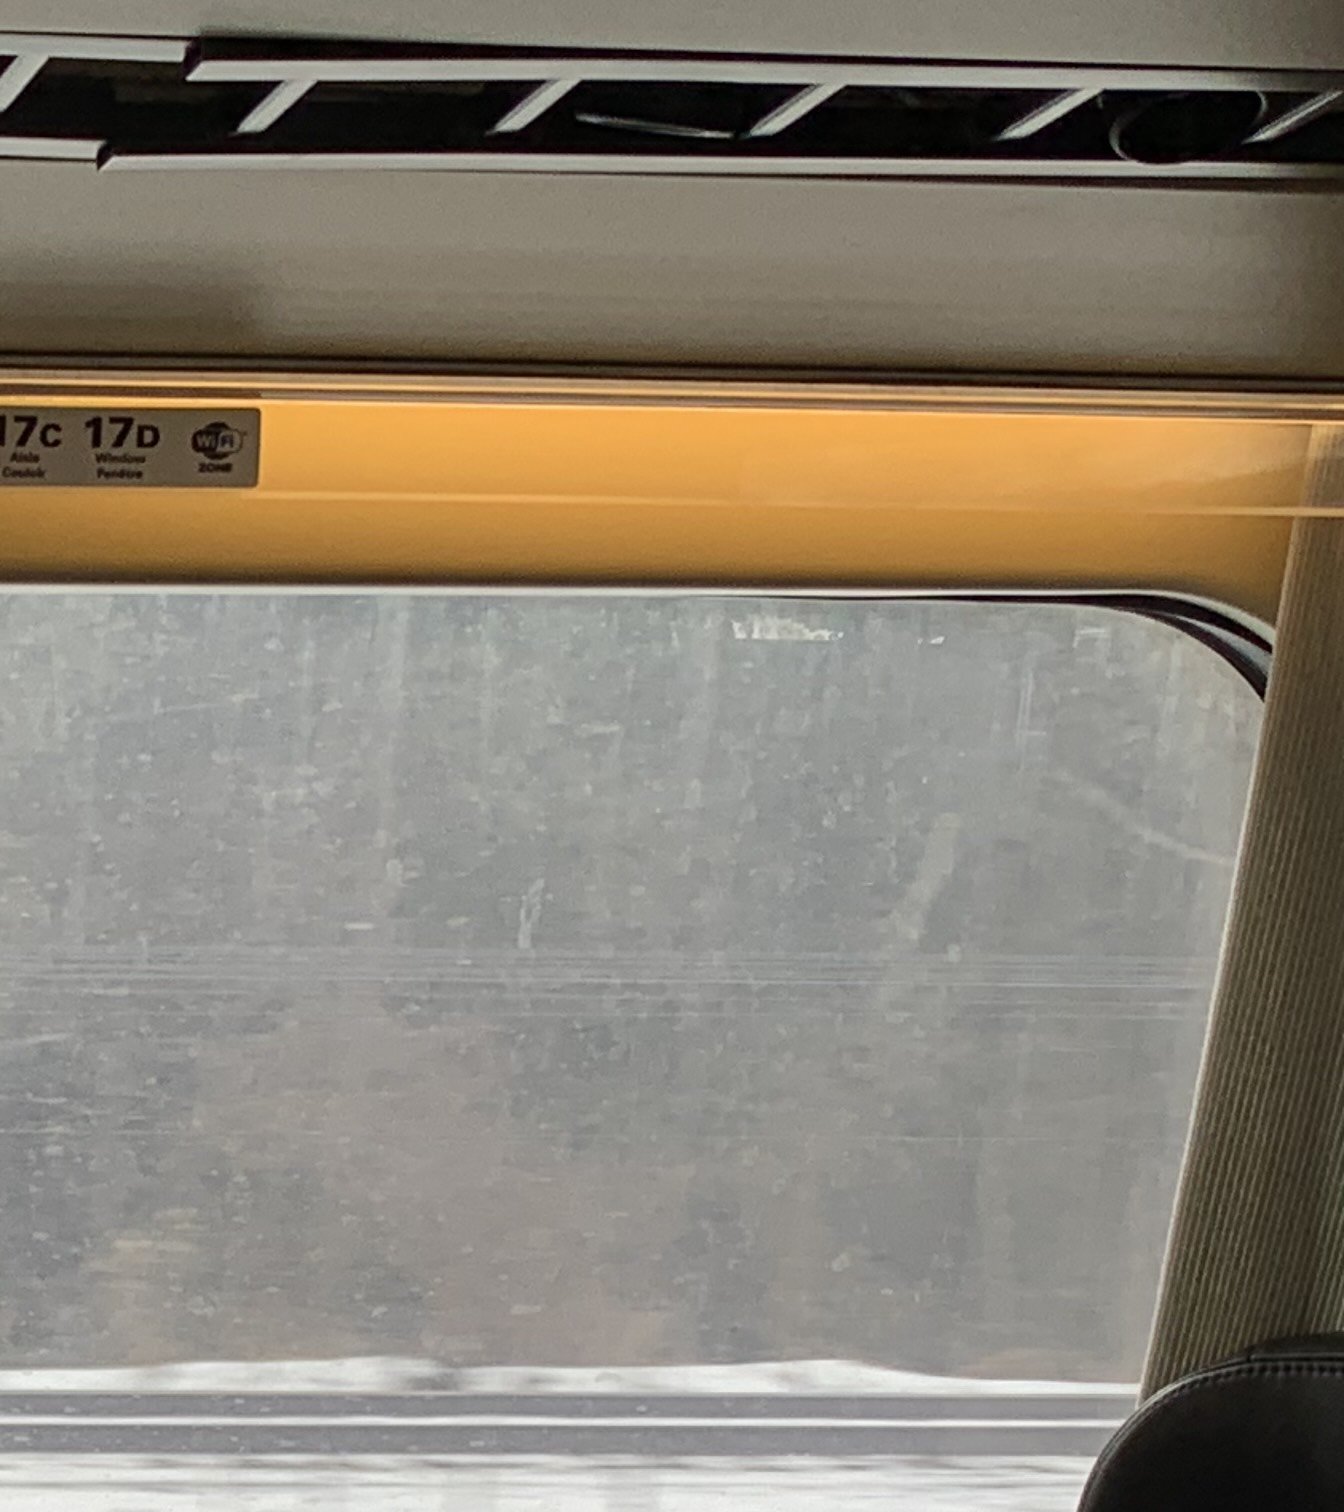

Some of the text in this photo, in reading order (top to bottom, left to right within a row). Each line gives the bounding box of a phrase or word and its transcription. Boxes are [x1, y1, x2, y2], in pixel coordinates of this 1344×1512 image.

[85, 417, 161, 449] 17D
[10, 452, 146, 464] Aisle Window
[198, 462, 233, 473] ZONE
